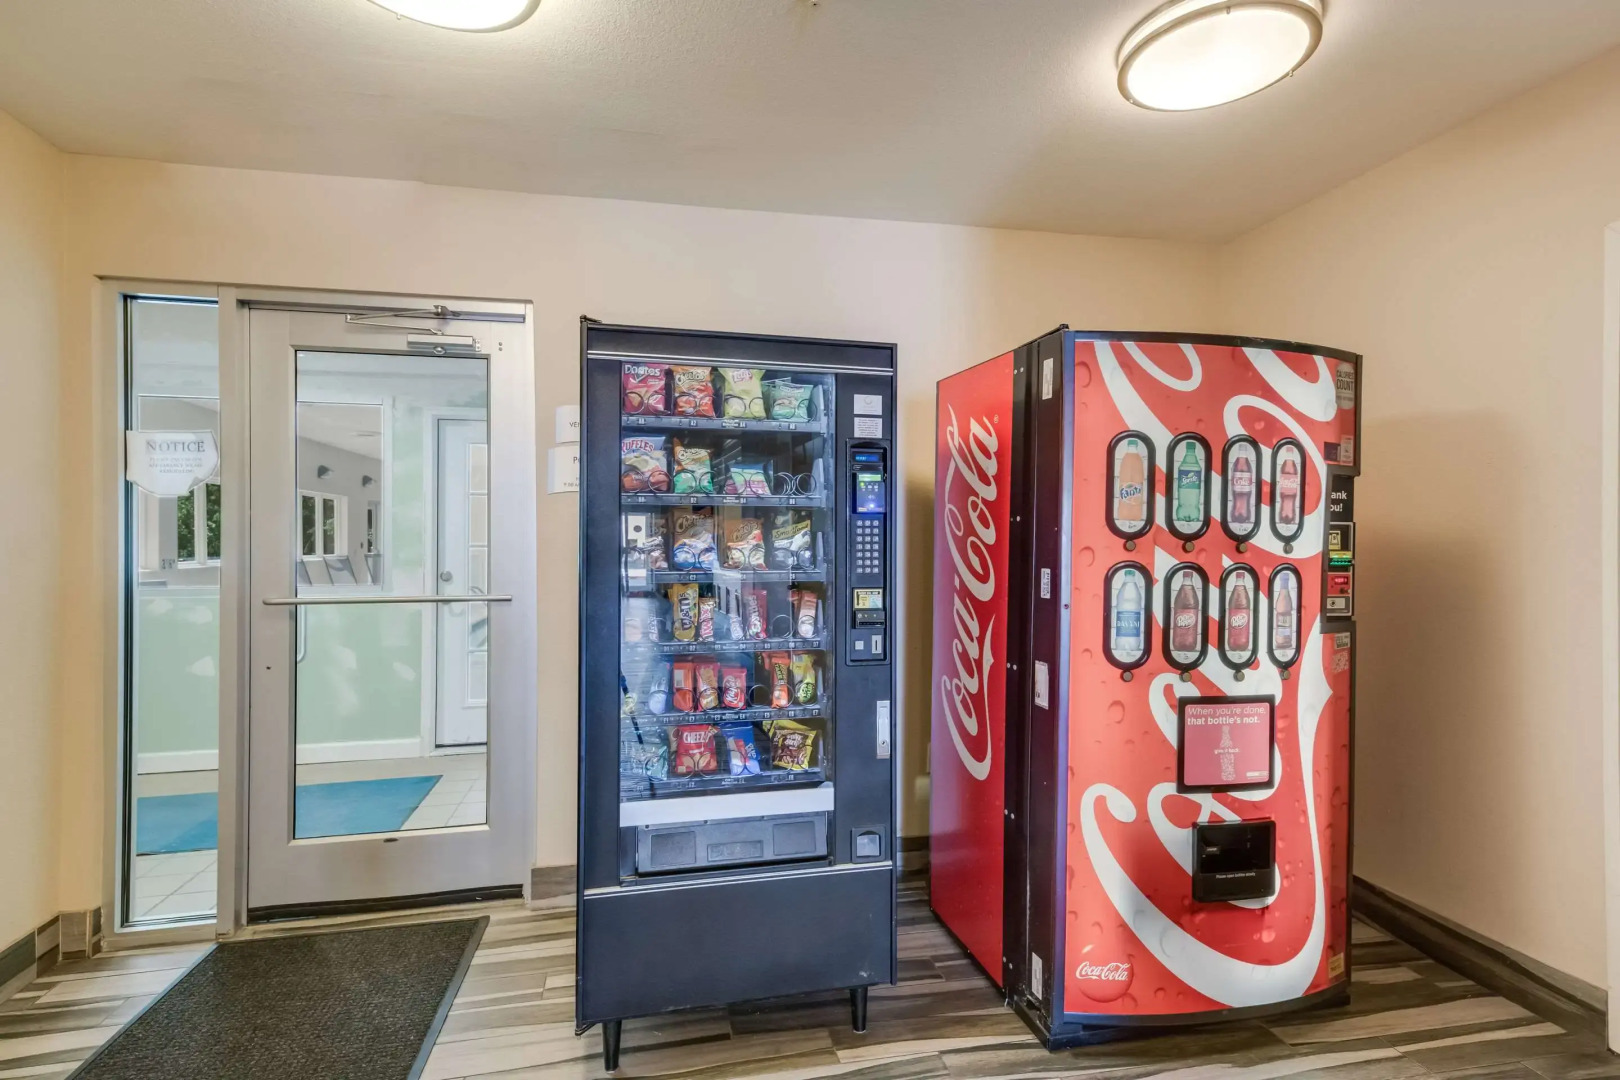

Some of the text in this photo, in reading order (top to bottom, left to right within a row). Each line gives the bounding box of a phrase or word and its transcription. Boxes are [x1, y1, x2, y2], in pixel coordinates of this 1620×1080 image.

[624, 364, 660, 376] Doritos
[675, 370, 706, 385] Cheetos
[1336, 379, 1354, 391] COUNT
[146, 440, 205, 453] NOTICE
[1331, 490, 1347, 500] ank
[1330, 503, 1343, 512] ou!
[941, 403, 999, 781] Coca-Cola
[1188, 707, 1214, 715] When
[1216, 707, 1241, 716] you're
[1187, 716, 1260, 725] that bottle's not.
[1075, 961, 1131, 981] Coca-Cola
